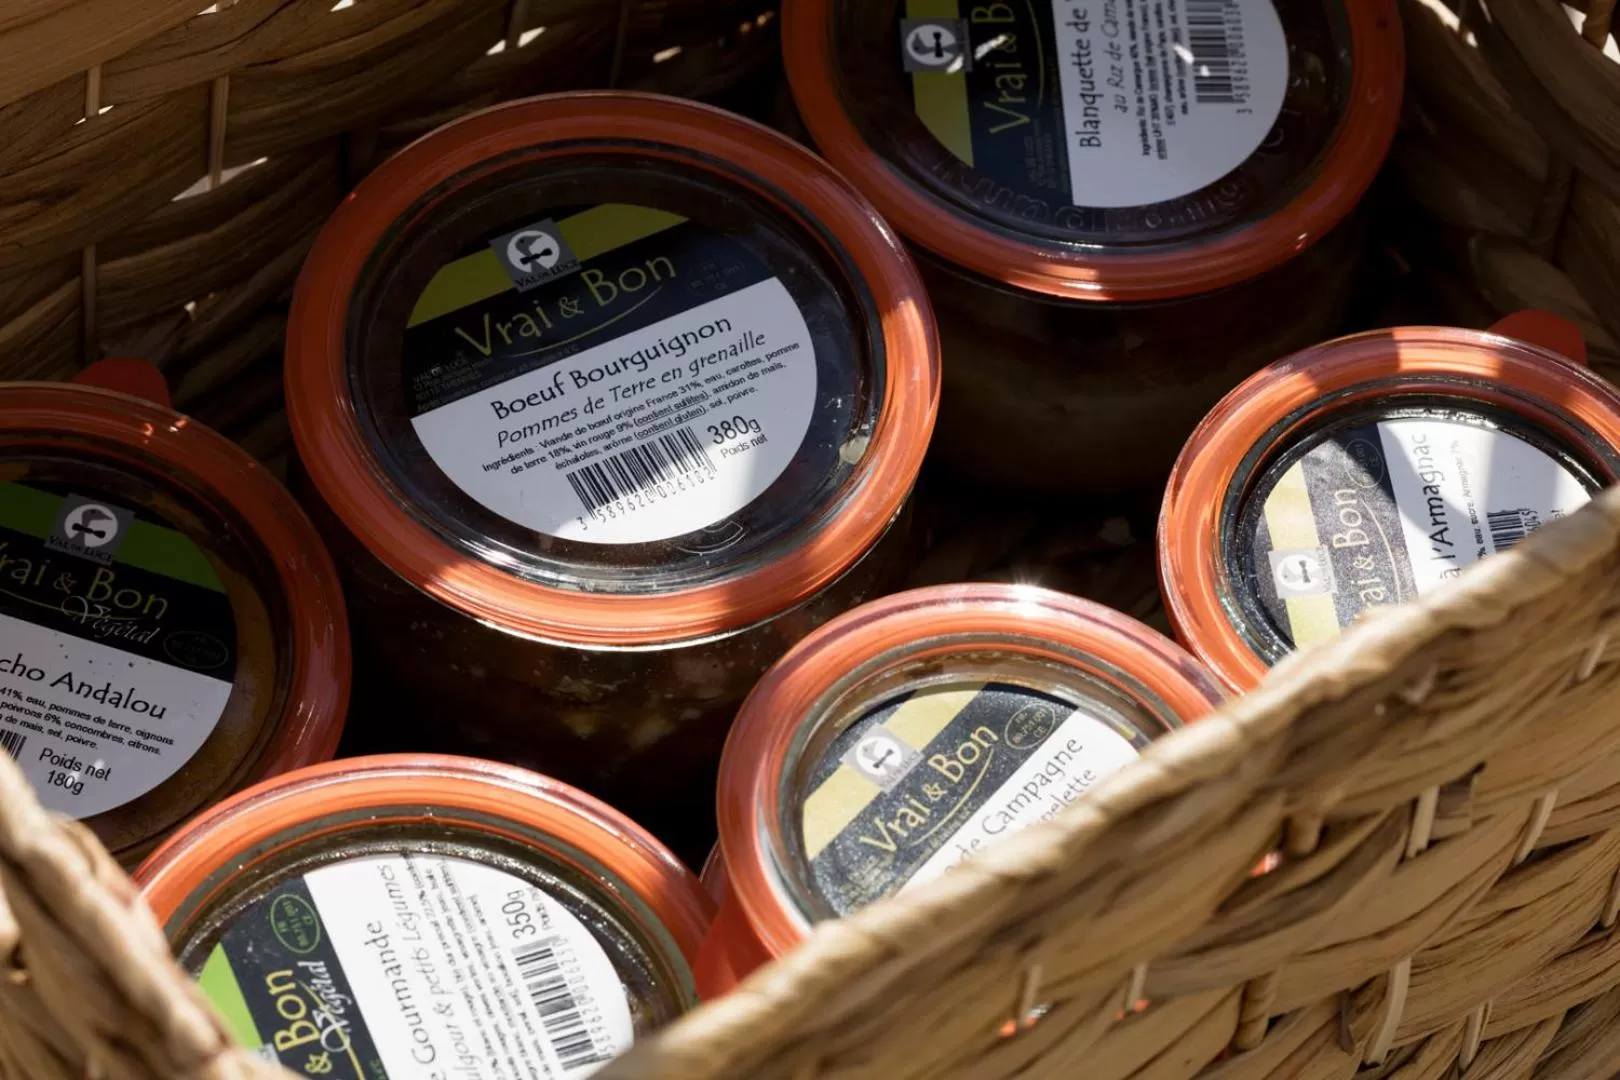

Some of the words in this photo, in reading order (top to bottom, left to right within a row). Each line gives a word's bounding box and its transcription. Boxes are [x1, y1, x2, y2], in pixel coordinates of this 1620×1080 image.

[1066, 8, 1090, 33] de
[1104, 41, 1123, 61] de
[983, 62, 1031, 134] Vrai
[1070, 39, 1104, 147] Blanquette
[1106, 64, 1125, 89] Riz
[1114, 94, 1128, 113] au
[455, 299, 554, 358] Vrai
[559, 296, 585, 319] &
[580, 257, 676, 307] Bon
[490, 371, 565, 420] Boeuf
[569, 319, 732, 389] Bourguignon
[498, 408, 578, 448] Pommes
[583, 396, 605, 414] de
[609, 377, 656, 402] Terre
[661, 367, 682, 383] en
[688, 330, 766, 375] grenaille
[482, 448, 535, 472] Ingrédients
[539, 432, 573, 448] Viande
[574, 427, 587, 435] de
[613, 404, 645, 420] origine
[645, 391, 679, 407] France
[765, 343, 800, 362] pomme
[510, 465, 523, 474] de
[523, 456, 548, 469] terre
[572, 440, 588, 449] vin
[588, 429, 616, 444] rouge
[616, 421, 634, 432] 9%
[712, 377, 746, 394] amidon
[747, 372, 760, 380] de
[603, 436, 633, 451] arôme
[726, 387, 755, 404] poivre.
[707, 415, 761, 444] 380g
[720, 442, 750, 458] Poids
[750, 433, 768, 447] net
[1332, 489, 1371, 548] Bon
[1353, 554, 1375, 570] &
[1440, 565, 1462, 580] à
[53, 572, 76, 597] &
[85, 567, 169, 620] Bon
[1350, 573, 1389, 605] ai
[0, 653, 45, 681] cho
[49, 672, 166, 719] Andalou
[0, 701, 43, 719] poivrons
[64, 721, 124, 745] concombres,
[4, 715, 18, 724] de
[65, 734, 99, 749] poivre.
[26, 696, 46, 709] eau,
[48, 703, 92, 721] pommes
[93, 716, 106, 725] de
[108, 719, 132, 734] terre,
[135, 729, 174, 745] oignons
[39, 747, 82, 771] Poids
[85, 762, 112, 782] net
[927, 726, 999, 783] Bon
[48, 770, 84, 795] 180g
[924, 782, 948, 801] &
[955, 838, 981, 863] de
[982, 739, 1083, 835] Campagne
[858, 794, 931, 854] Vrai
[377, 864, 423, 942] Légumes
[501, 890, 536, 939] 350g
[365, 920, 437, 1064] Gourmande
[414, 947, 453, 996] petits
[266, 969, 325, 1052] Bon
[297, 960, 353, 1053] Végétal
[433, 1003, 454, 1017] &
[305, 1051, 333, 1074] &
